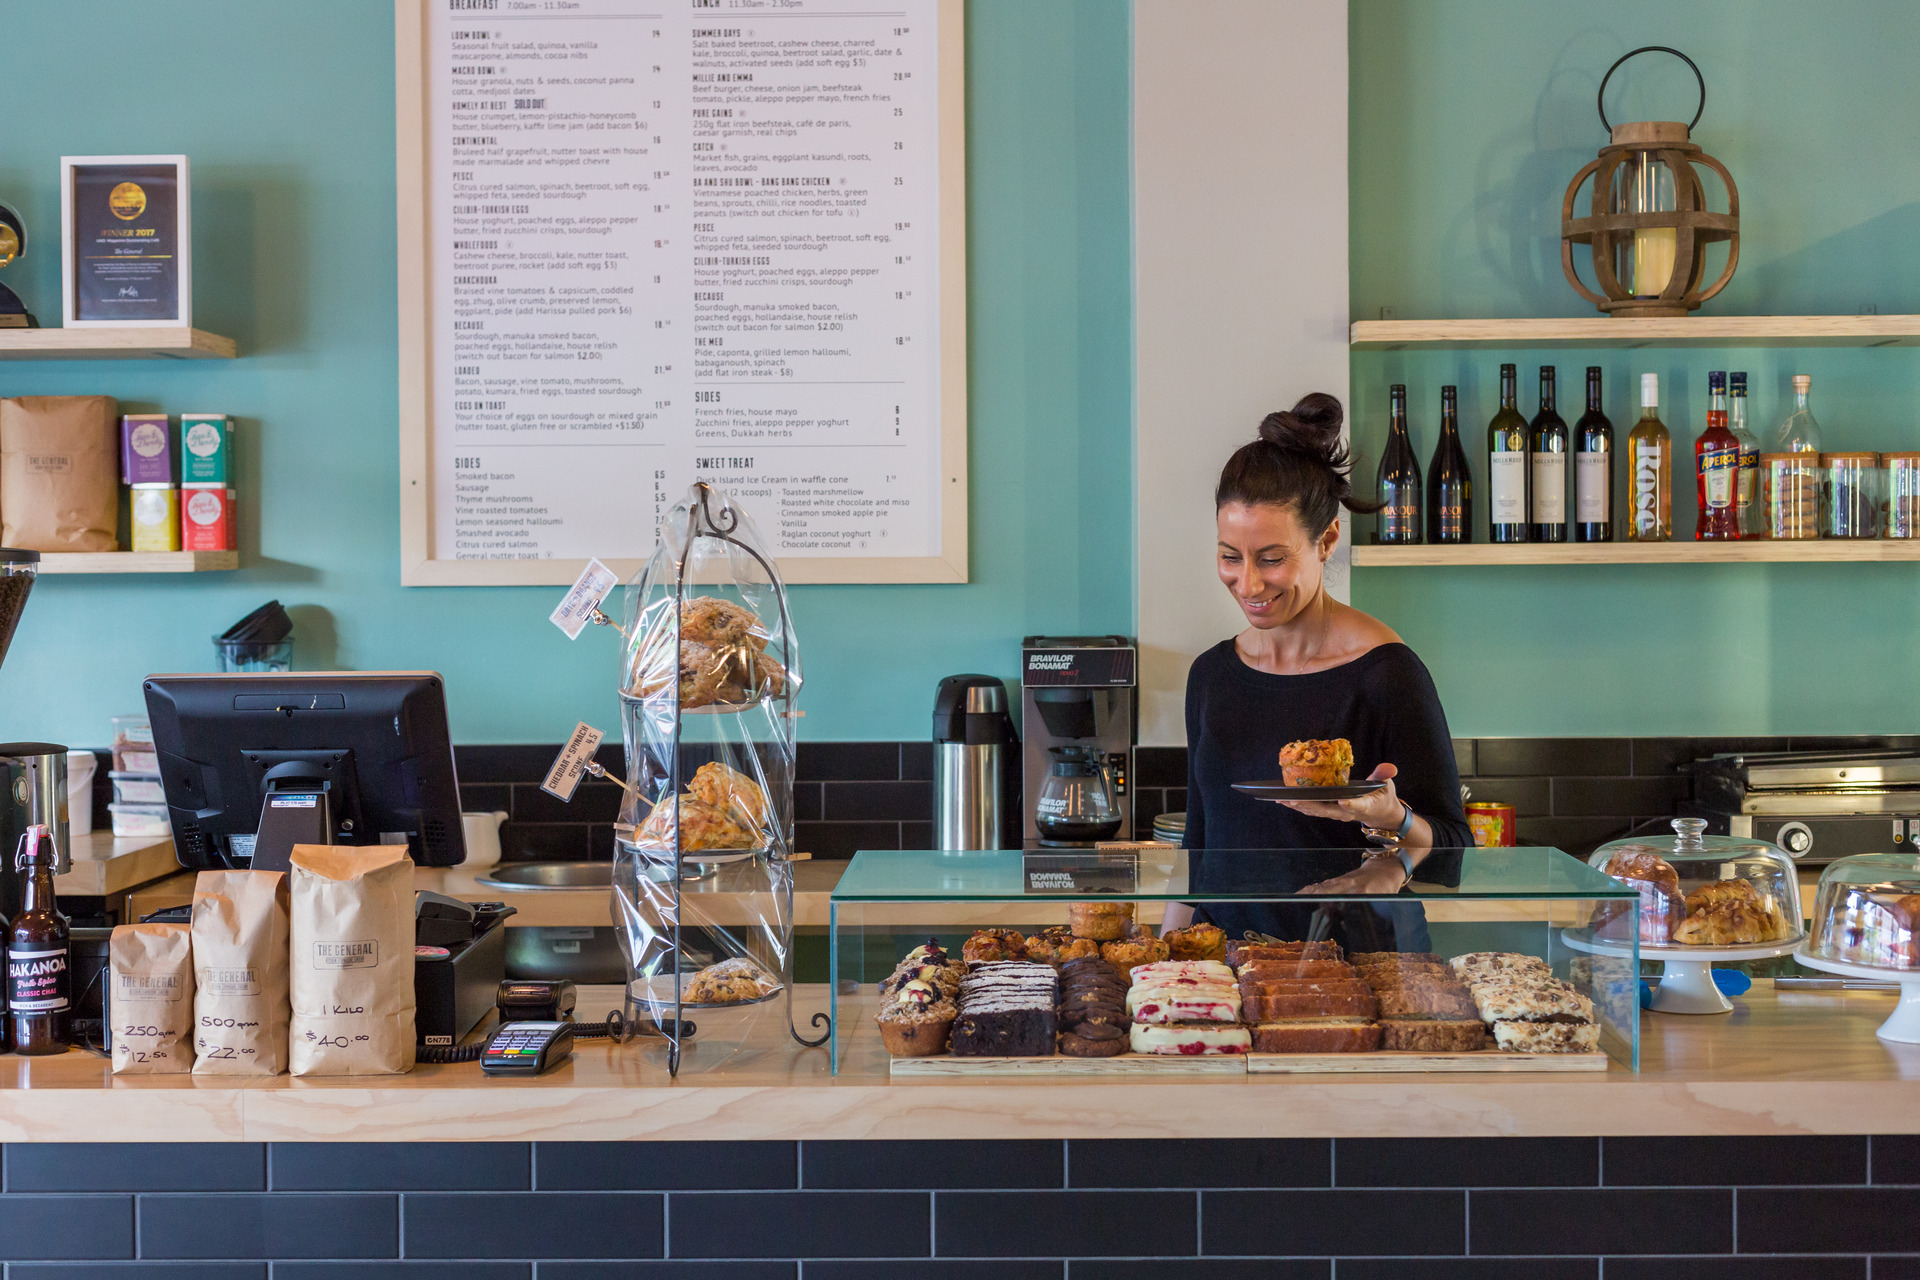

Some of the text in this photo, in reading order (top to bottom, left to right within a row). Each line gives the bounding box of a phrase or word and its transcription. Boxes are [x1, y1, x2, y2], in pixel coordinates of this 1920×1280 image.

[450, 0, 498, 10] BREAKFAST
[507, 1, 537, 10] 7.00am
[544, 1, 580, 10] 11.30am
[692, 0, 720, 8] LUNCH
[729, 0, 765, 8] 11.30am
[772, 0, 803, 9] 2.30pm
[452, 31, 490, 40] LOOM BOWL
[692, 29, 740, 38] SUMMER DAYS
[451, 41, 489, 50] Seasonal
[491, 42, 509, 50] fruit
[512, 42, 536, 51] salad,
[537, 42, 569, 50] quinoa,
[692, 73, 753, 82] MILLIE AND EMMA
[452, 101, 506, 110] HOMELY AT BEST
[514, 98, 545, 110] SOLD OUT
[452, 112, 637, 121] House crumpet, lemon-pistachio-honeycomb
[692, 109, 732, 118] PURE GAINS
[894, 108, 903, 116] 25
[452, 137, 497, 145] CONTINENTAL
[452, 172, 474, 181] PESCE
[511, 205, 529, 214] EGGS
[101, 229, 155, 237] WINNER 2017
[454, 321, 484, 330] BECAUSE
[454, 332, 600, 342] Sourdough, manuka smoked bacon,
[694, 337, 723, 346] THE MED
[454, 341, 618, 352] poached eggs, hollandaise, house relish
[454, 366, 480, 375] LOADED
[695, 391, 721, 403] SIDES
[455, 401, 506, 410] EGGS ON TOAST
[695, 408, 798, 417] French fries, house mayo
[695, 429, 793, 438] Greens, Dukkah herbs
[29, 456, 68, 465] THE GENERAL
[455, 457, 481, 469] SIDES
[696, 457, 754, 469] SWEET TREAT
[1701, 453, 1736, 470] APEROL
[1739, 454, 1758, 467] EROL
[454, 472, 515, 481] Smoked bacon
[654, 470, 665, 479] 6.5
[696, 476, 717, 484] Duck
[719, 476, 744, 484] Island
[747, 476, 759, 484] Ice
[761, 475, 788, 484] Cream
[800, 475, 826, 483] waffle
[455, 483, 490, 493] Sausage
[782, 488, 811, 496] Toasted
[812, 488, 864, 496] marshmellow
[455, 494, 534, 504] Thyme mushrooms
[654, 492, 666, 502] 5.5
[455, 517, 563, 526] Lemon seasoned halloumi
[455, 528, 530, 537] Smashed avocado
[455, 540, 480, 549] Citrus
[482, 540, 506, 549] cured
[455, 551, 488, 560] General
[518, 552, 539, 560] toast
[560, 599, 577, 618] DATE
[575, 572, 598, 599] ORANGE
[1030, 654, 1074, 662] BRAVILOR
[1028, 662, 1071, 670] BONAMAT
[585, 731, 599, 746] 4.5
[548, 757, 570, 790] CHEDDAR
[568, 725, 589, 756] SPINACH
[318, 943, 373, 956] THE GENERAL
[9, 957, 67, 977] HAKANOA
[219, 970, 257, 983] GENERAL
[122, 976, 177, 988] THE GENERAL
[16, 988, 57, 998] CLASSIC CHAI
